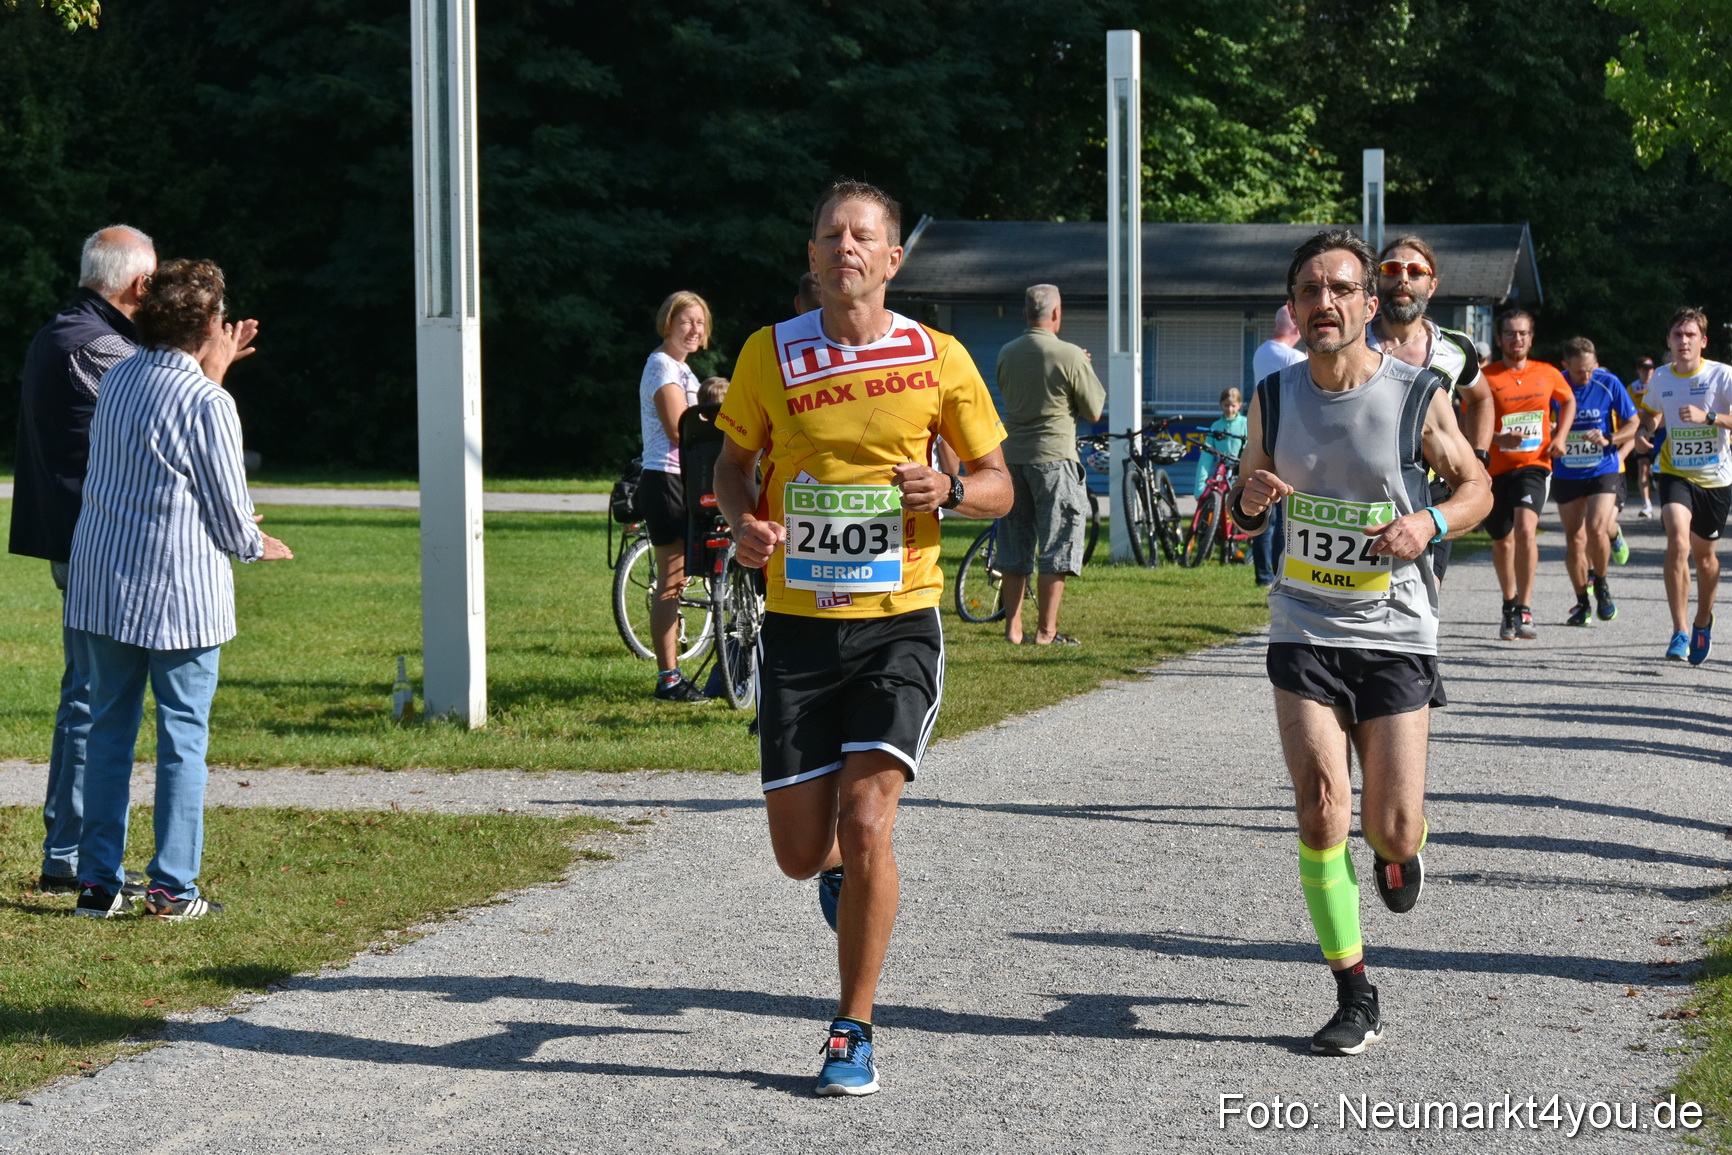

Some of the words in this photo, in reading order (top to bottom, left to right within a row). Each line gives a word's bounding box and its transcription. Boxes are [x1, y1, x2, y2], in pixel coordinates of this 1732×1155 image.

[786, 382, 857, 417] MAX
[864, 370, 940, 398] BÖGL
[718, 411, 748, 436] oegl.de
[1574, 408, 1601, 419] CAD
[1674, 429, 1713, 438] BOCK
[1566, 443, 1598, 455] 2149
[1675, 441, 1713, 456] 2523
[793, 488, 893, 514] BOCK
[1293, 496, 1384, 527] BOCK
[797, 521, 889, 555] 2403
[1297, 529, 1380, 566] 1324
[811, 564, 873, 579] BERND
[1311, 569, 1355, 588] KARL
